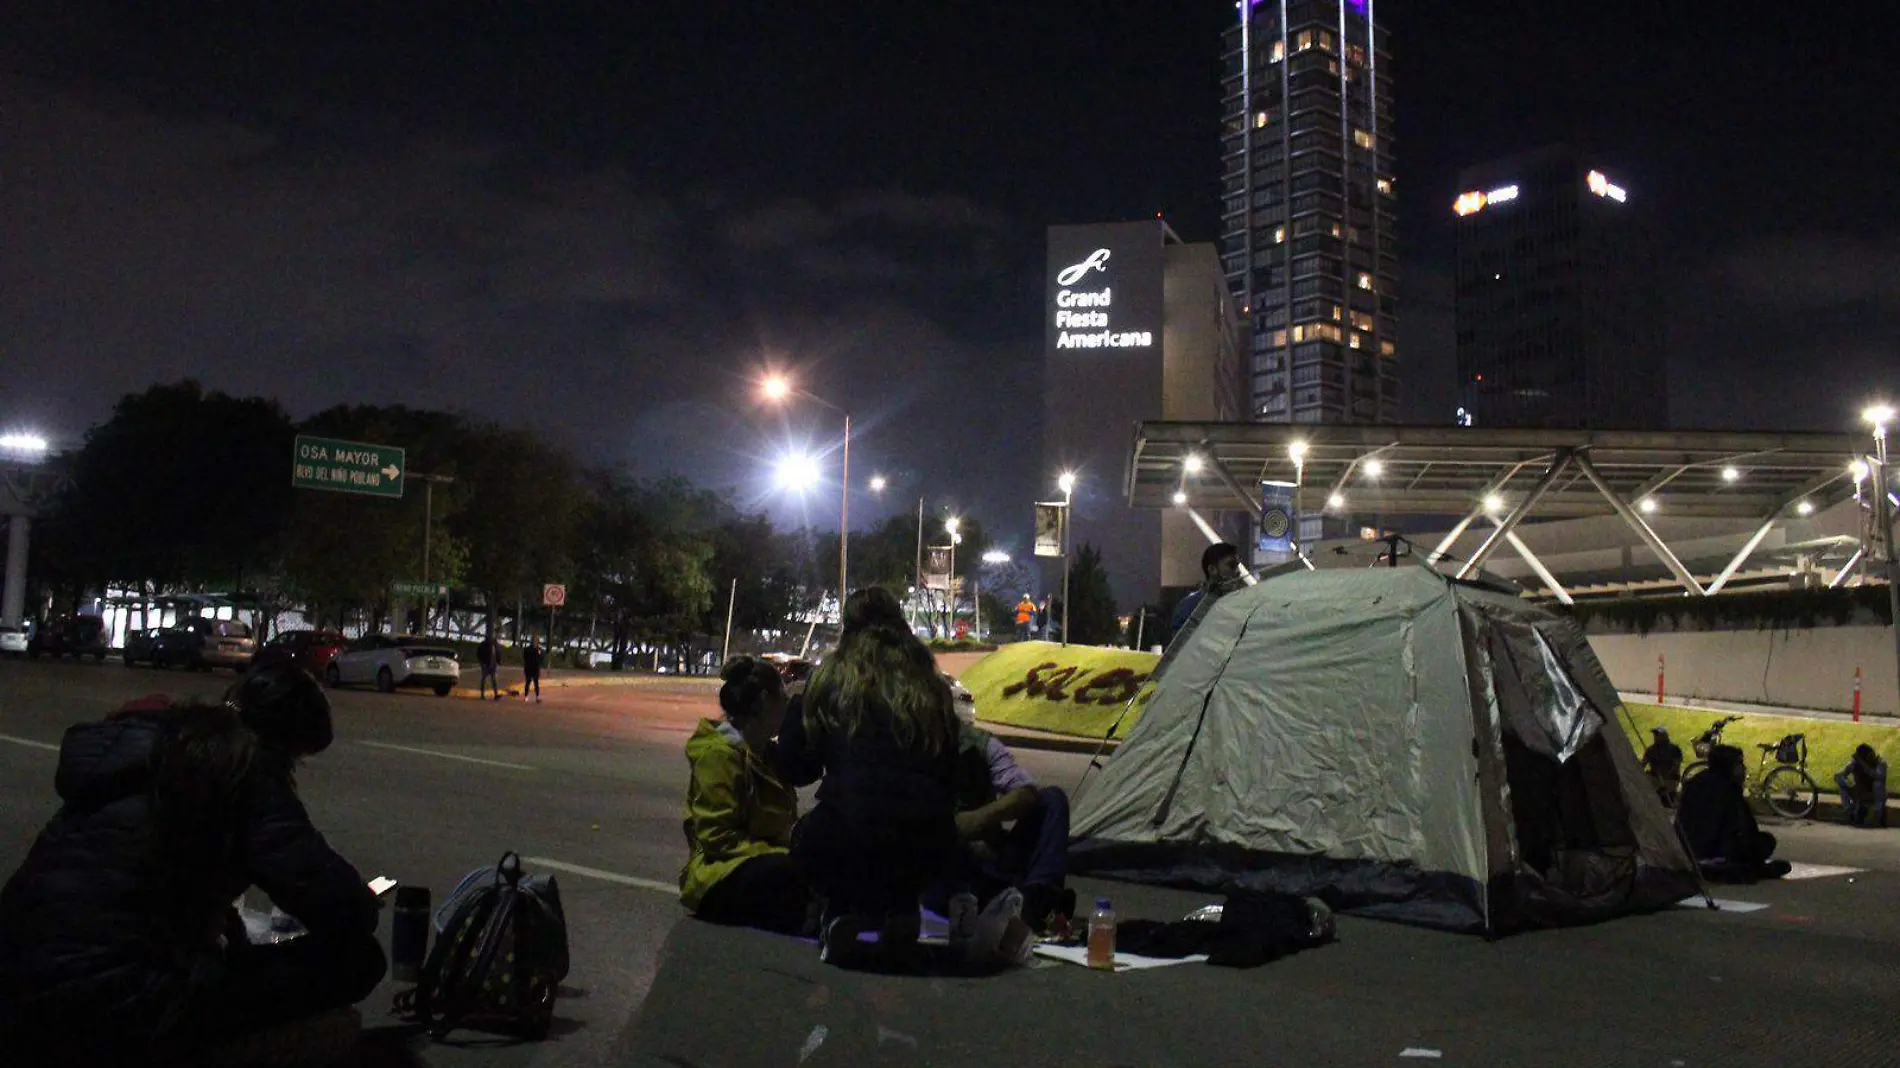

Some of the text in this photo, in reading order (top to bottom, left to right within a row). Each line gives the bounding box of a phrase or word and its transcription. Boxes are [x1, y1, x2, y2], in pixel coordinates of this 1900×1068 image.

[1057, 287, 1111, 308] Grand
[1056, 310, 1109, 329] Fiesta
[1057, 330, 1152, 349] Americana
[300, 445, 379, 466] OSA MAYOR
